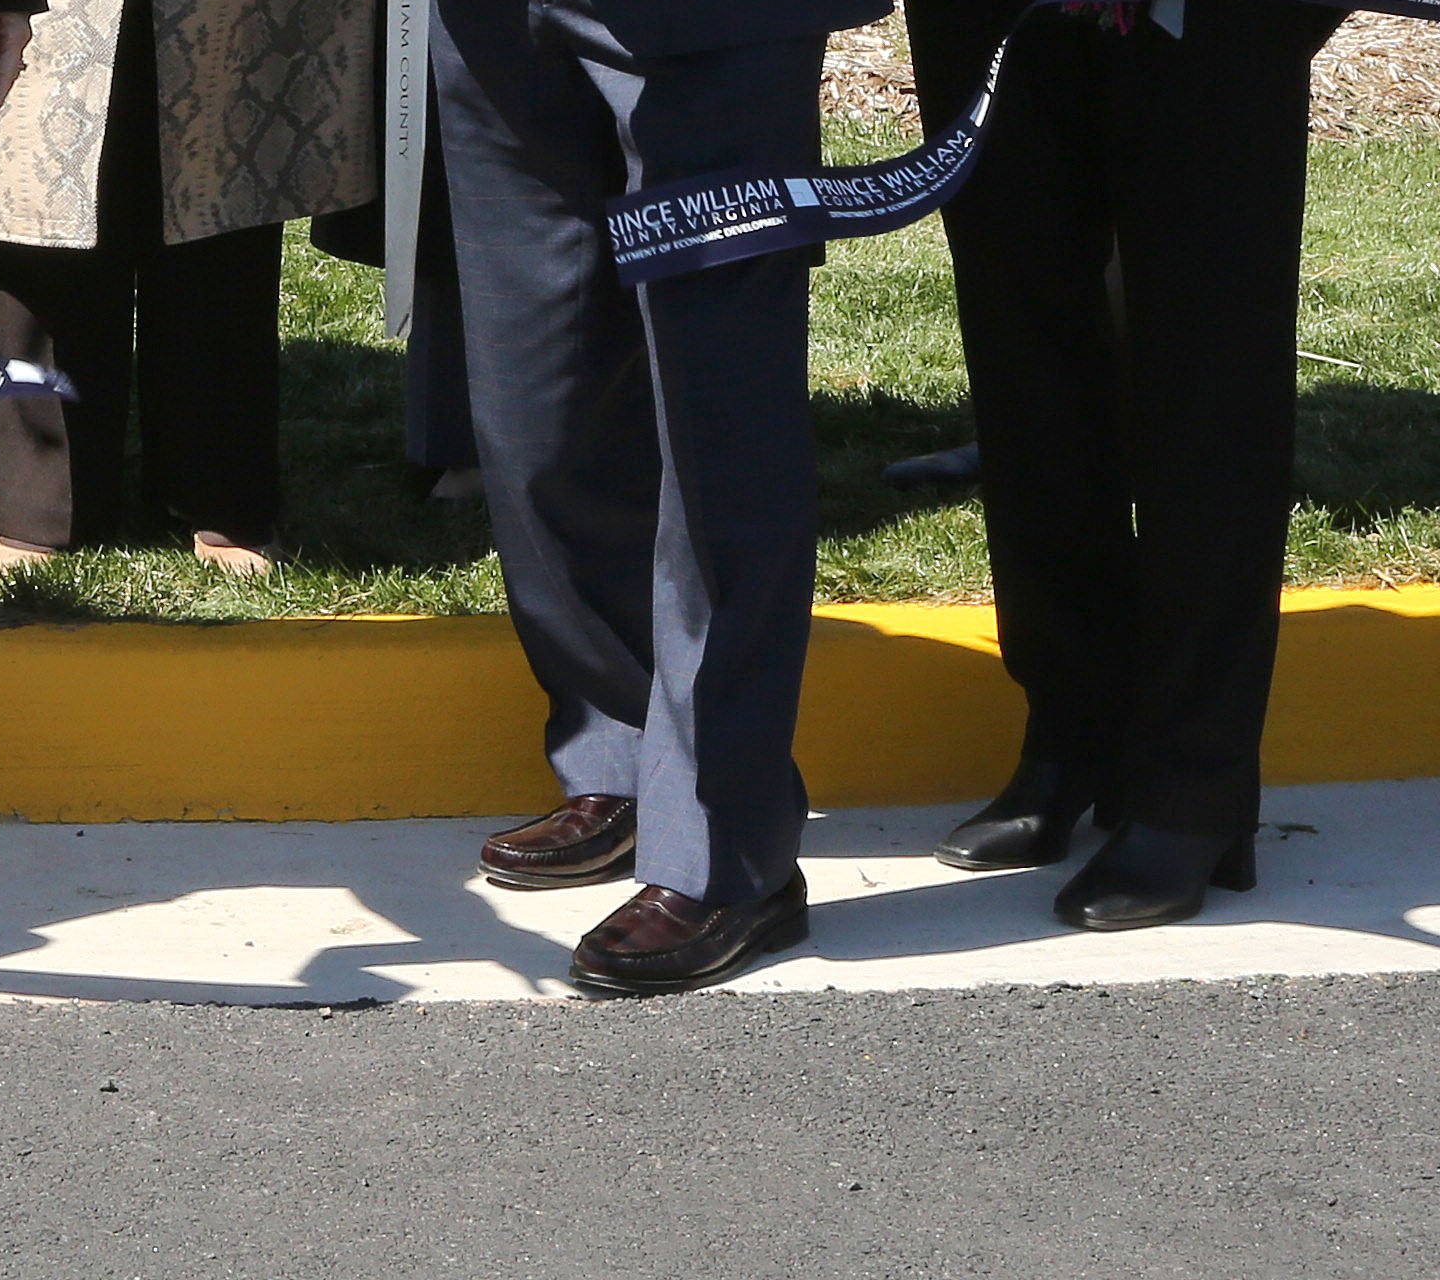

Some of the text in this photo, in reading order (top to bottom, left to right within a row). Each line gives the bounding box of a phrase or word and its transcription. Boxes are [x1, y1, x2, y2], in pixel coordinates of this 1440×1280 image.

[398, 56, 410, 160] COUNTY
[812, 129, 967, 197] PRINCE WILLIAM
[607, 178, 780, 237] RINCE WILLIAM
[613, 198, 785, 251] OUNTY, VIRGINIA
[659, 241, 671, 254] OF
[673, 230, 724, 251] ECONOMIC
[724, 214, 788, 239] DEVELOPMENT
